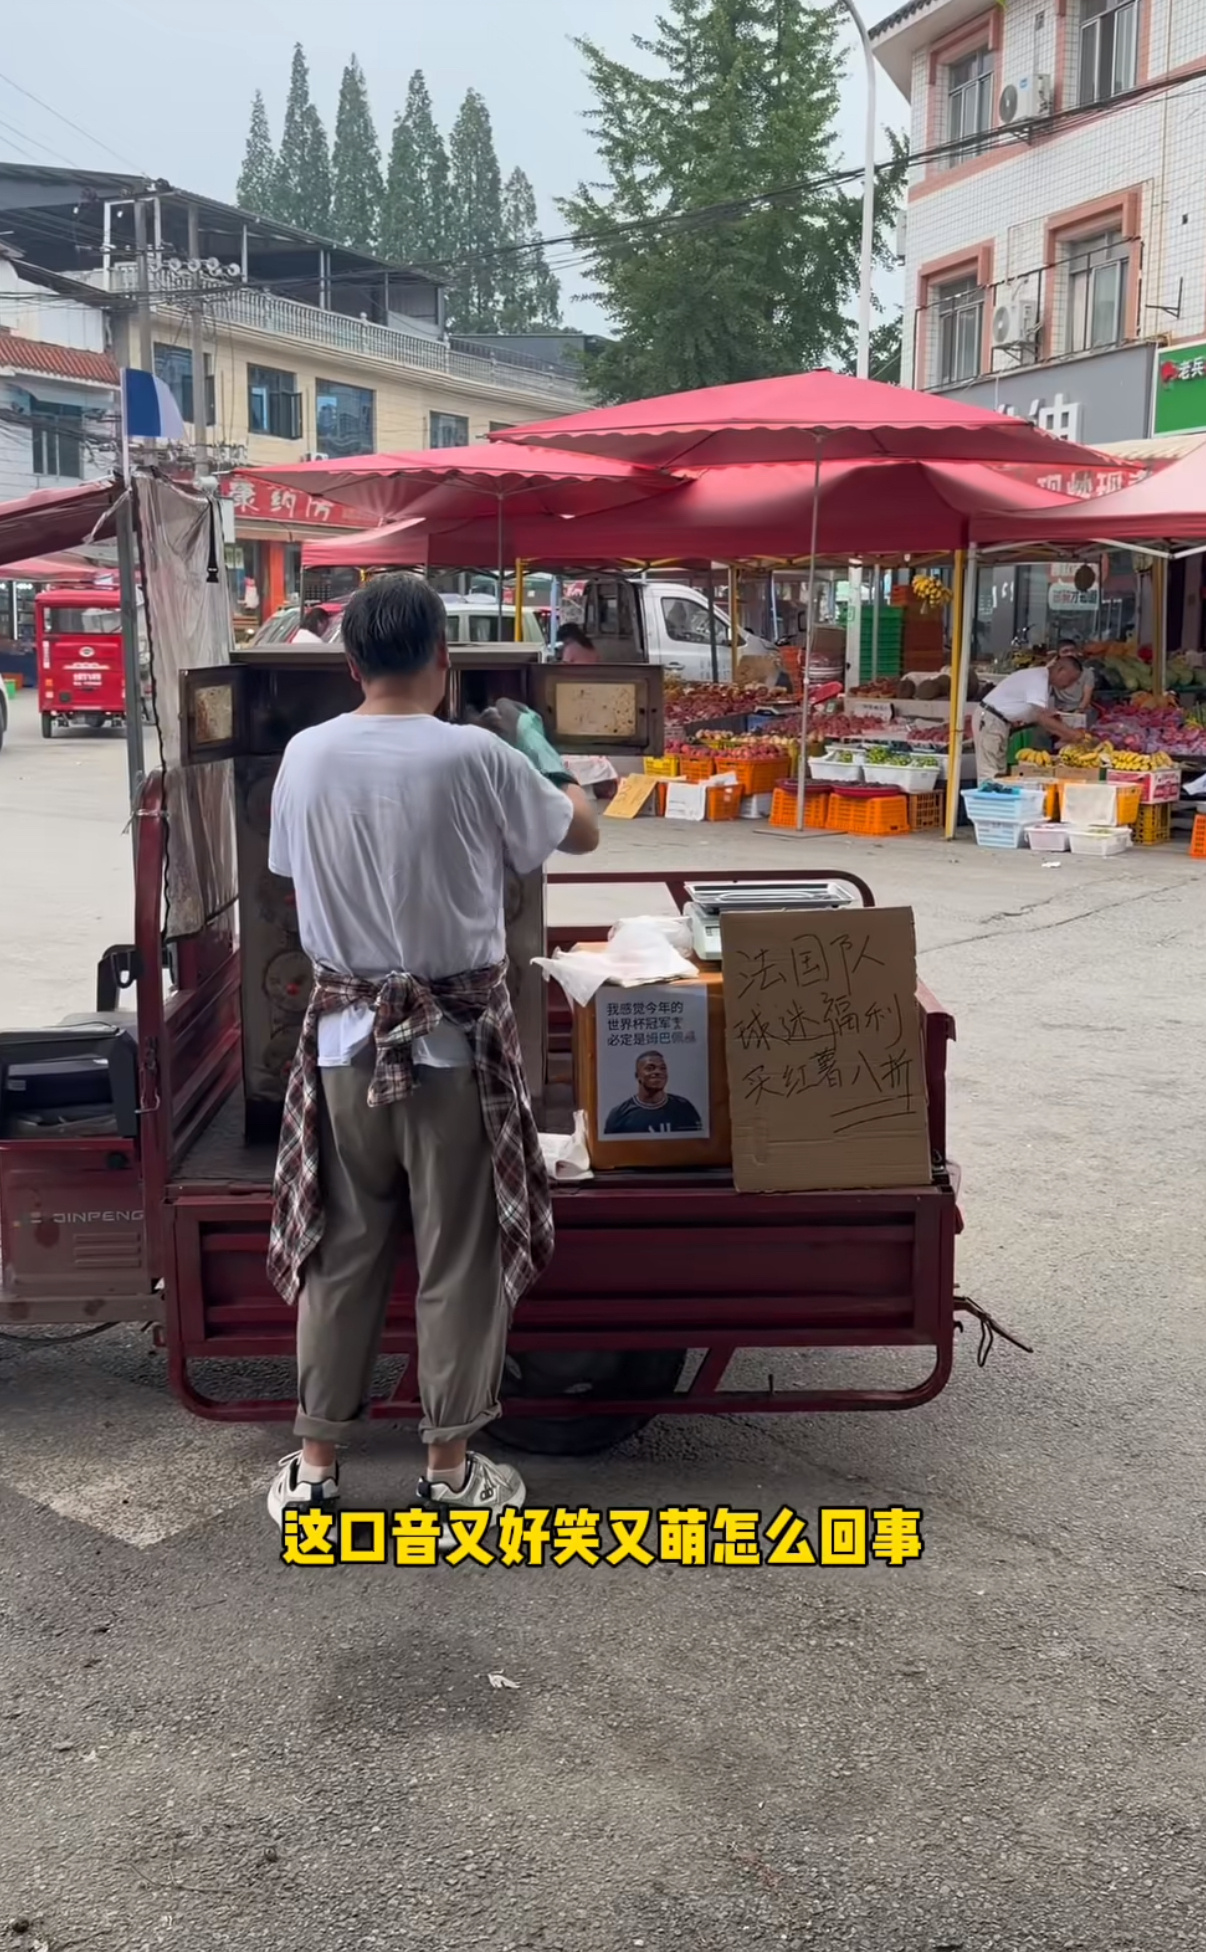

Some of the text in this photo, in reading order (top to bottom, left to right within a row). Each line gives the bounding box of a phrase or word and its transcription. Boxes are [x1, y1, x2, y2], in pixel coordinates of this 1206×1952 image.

[736, 934, 885, 999] 法国队
[607, 1001, 684, 1016] 我感觉今年的
[607, 1016, 671, 1031] 世界杯冠军
[733, 992, 902, 1051] 球迷福利
[53, 1210, 145, 1223] JINPENG
